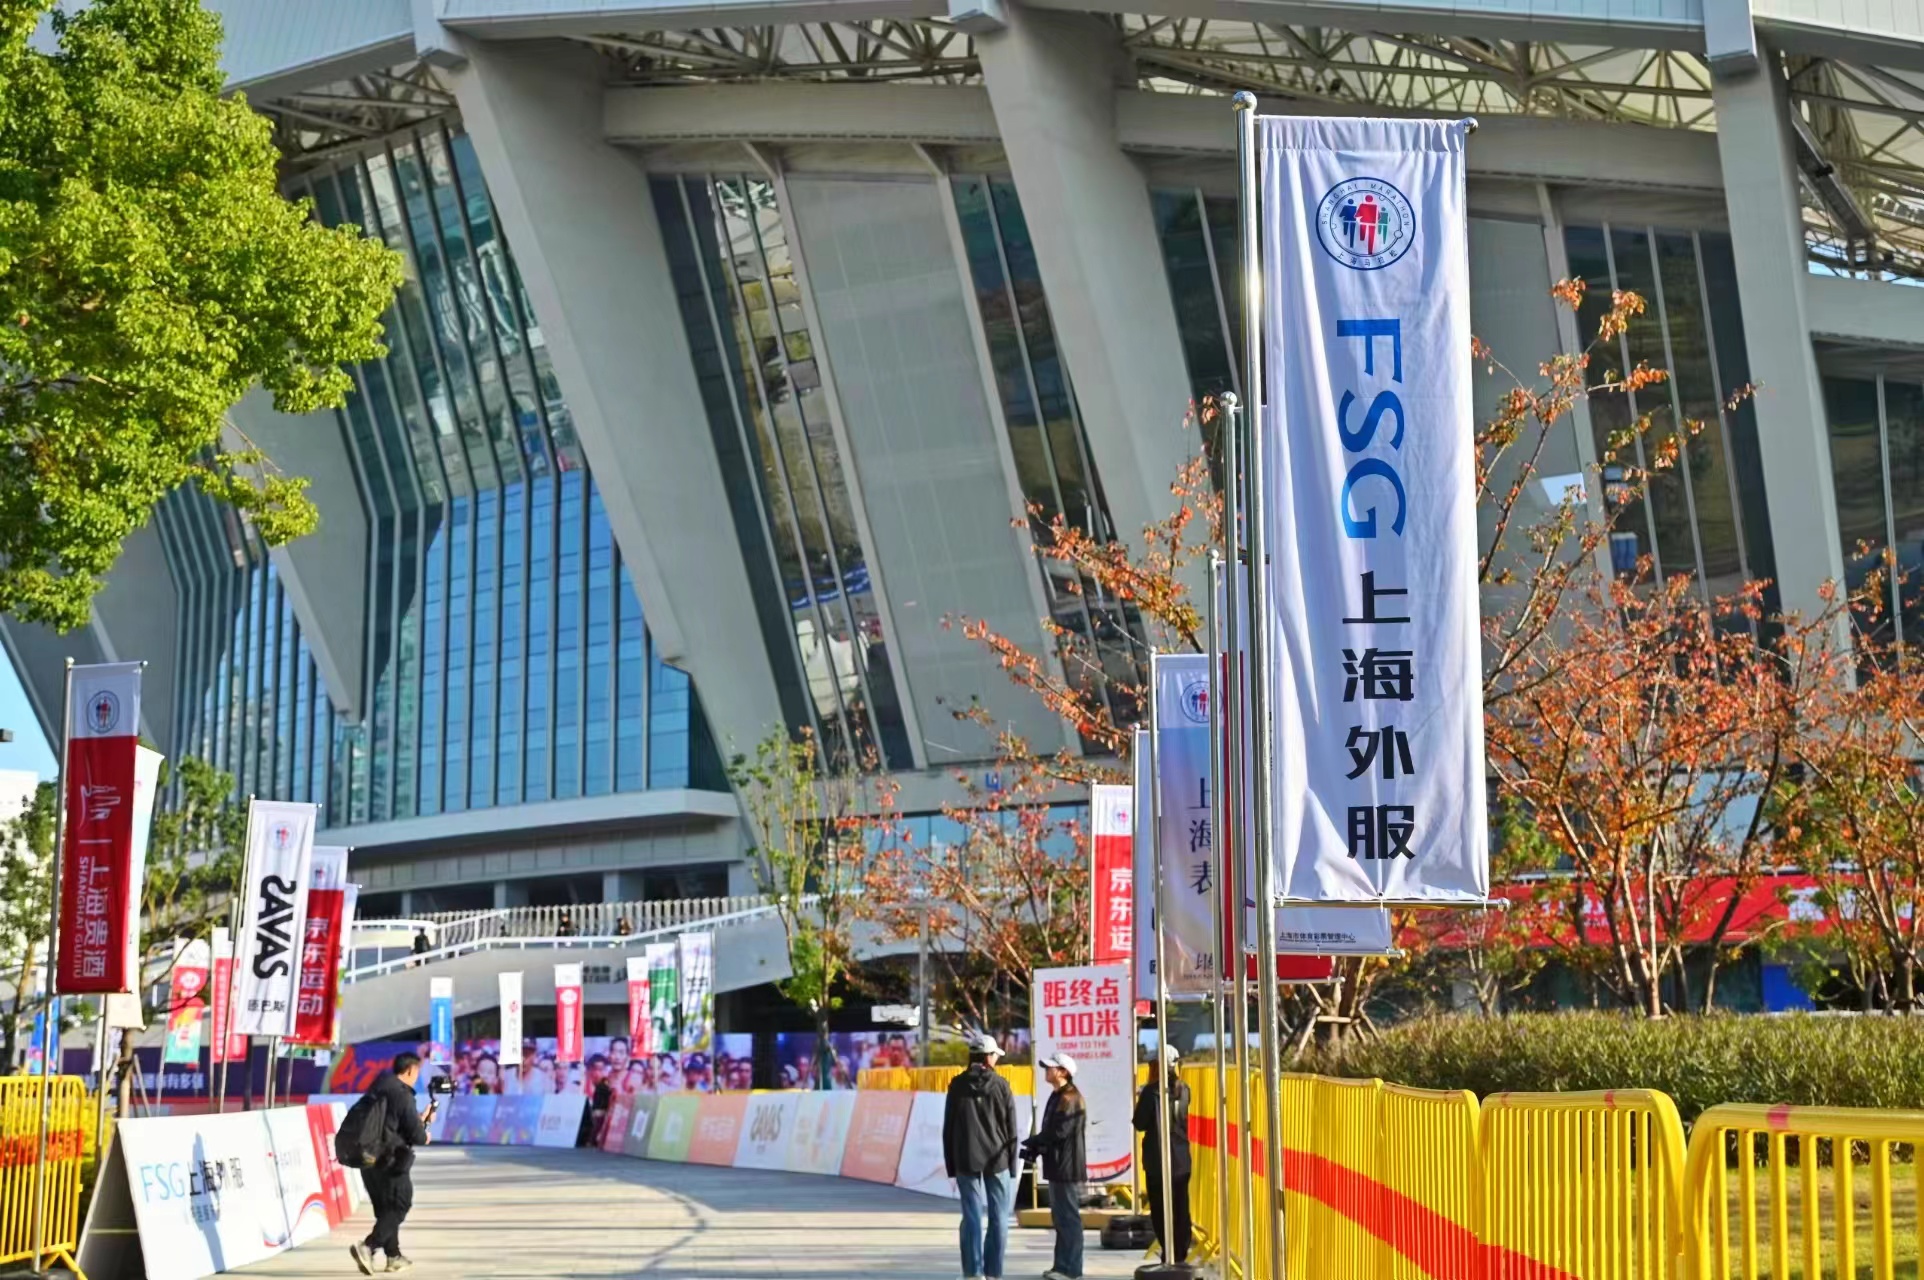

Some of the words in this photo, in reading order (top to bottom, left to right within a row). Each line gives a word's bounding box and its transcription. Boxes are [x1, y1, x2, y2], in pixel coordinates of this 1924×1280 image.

[1321, 183, 1358, 225] SHANGHAI
[1370, 183, 1410, 226] MARATHON
[1336, 318, 1407, 539] FSG
[1341, 570, 1416, 860] 上海外服
[76, 856, 89, 929] SHANGHAI
[83, 855, 110, 978] 上海贵酒
[252, 874, 297, 980] SAVAS
[298, 917, 330, 1017] 京东运动
[1043, 977, 1120, 1008] 距终点
[1045, 1009, 1121, 1039] 100米
[140, 1162, 186, 1203] FSG
